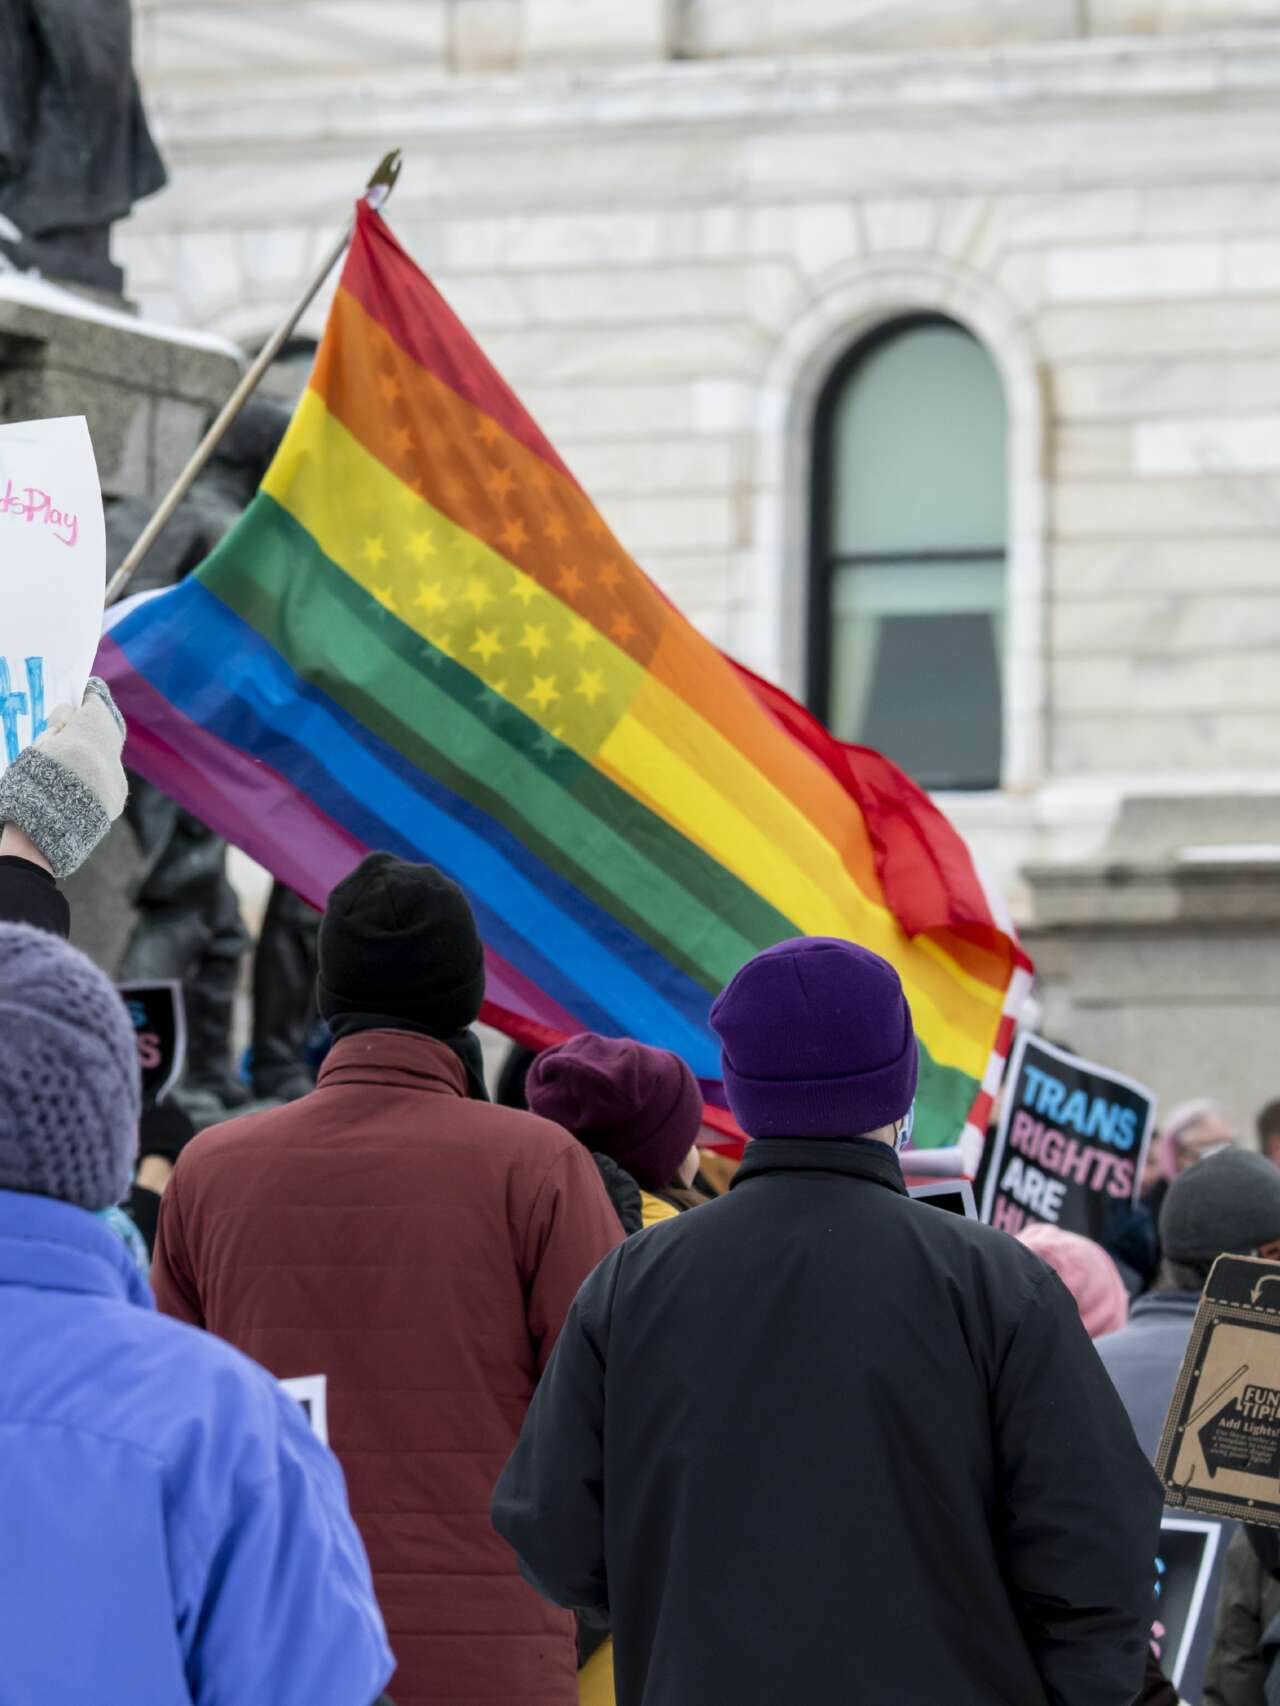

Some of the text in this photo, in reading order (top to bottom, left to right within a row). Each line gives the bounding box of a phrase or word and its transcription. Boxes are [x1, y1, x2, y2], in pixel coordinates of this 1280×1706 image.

[1023, 1064, 1138, 1150] TRANS
[1000, 1156, 1067, 1222] ARE
[1010, 1109, 1135, 1199] RIGHTS
[1218, 1417, 1241, 1430] Add
